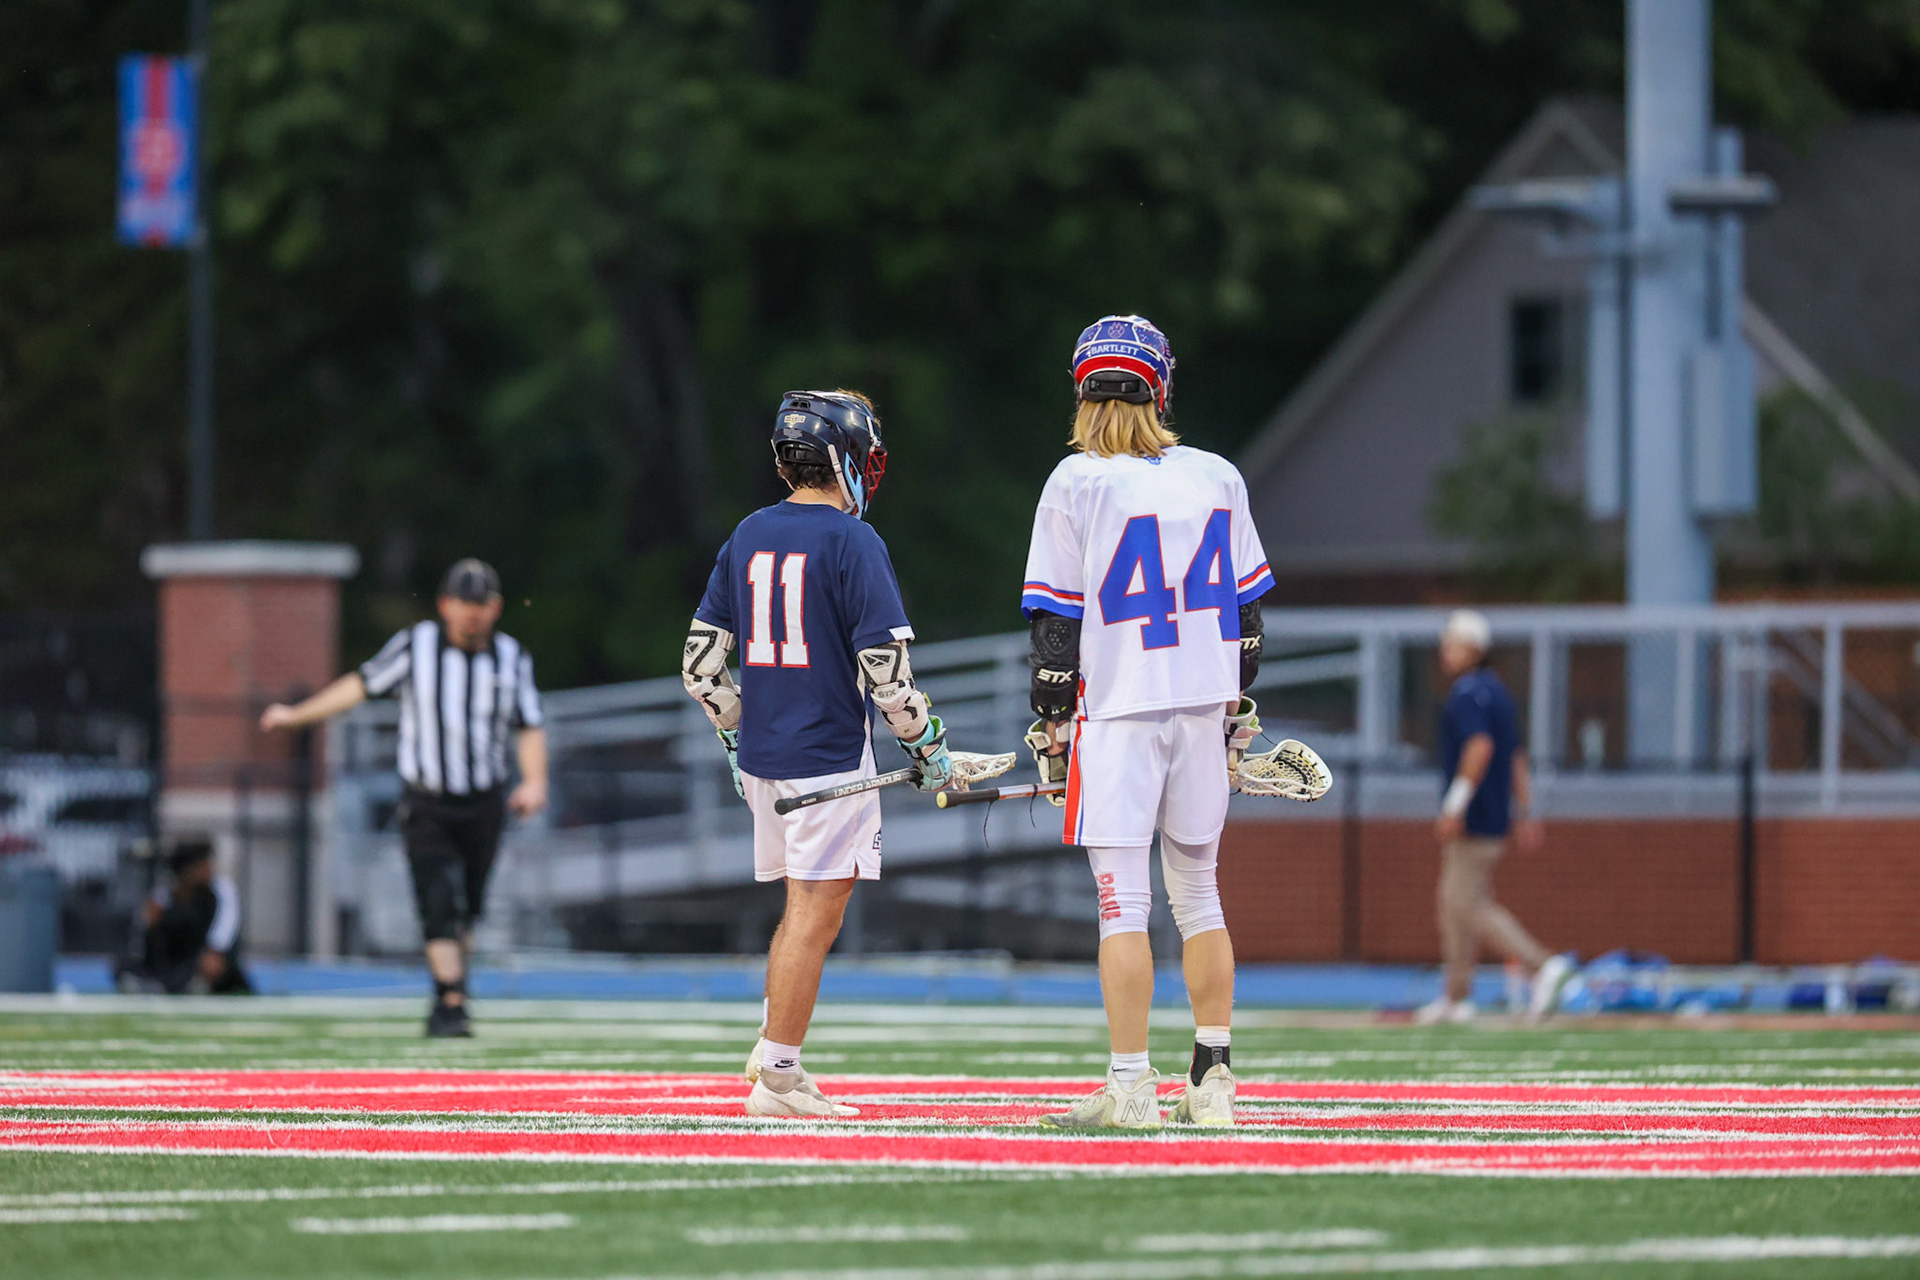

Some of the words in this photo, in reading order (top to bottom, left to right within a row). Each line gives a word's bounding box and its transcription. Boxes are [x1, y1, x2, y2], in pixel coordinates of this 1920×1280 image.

[1091, 344, 1139, 356] BARTLETT
[1098, 508, 1240, 651] 44
[746, 550, 810, 668] 11
[1240, 635, 1261, 650] TX
[1036, 668, 1074, 683] STX
[834, 783, 864, 797] UNDER
[865, 773, 902, 791] ARMOUR
[1120, 1099, 1150, 1122] N
